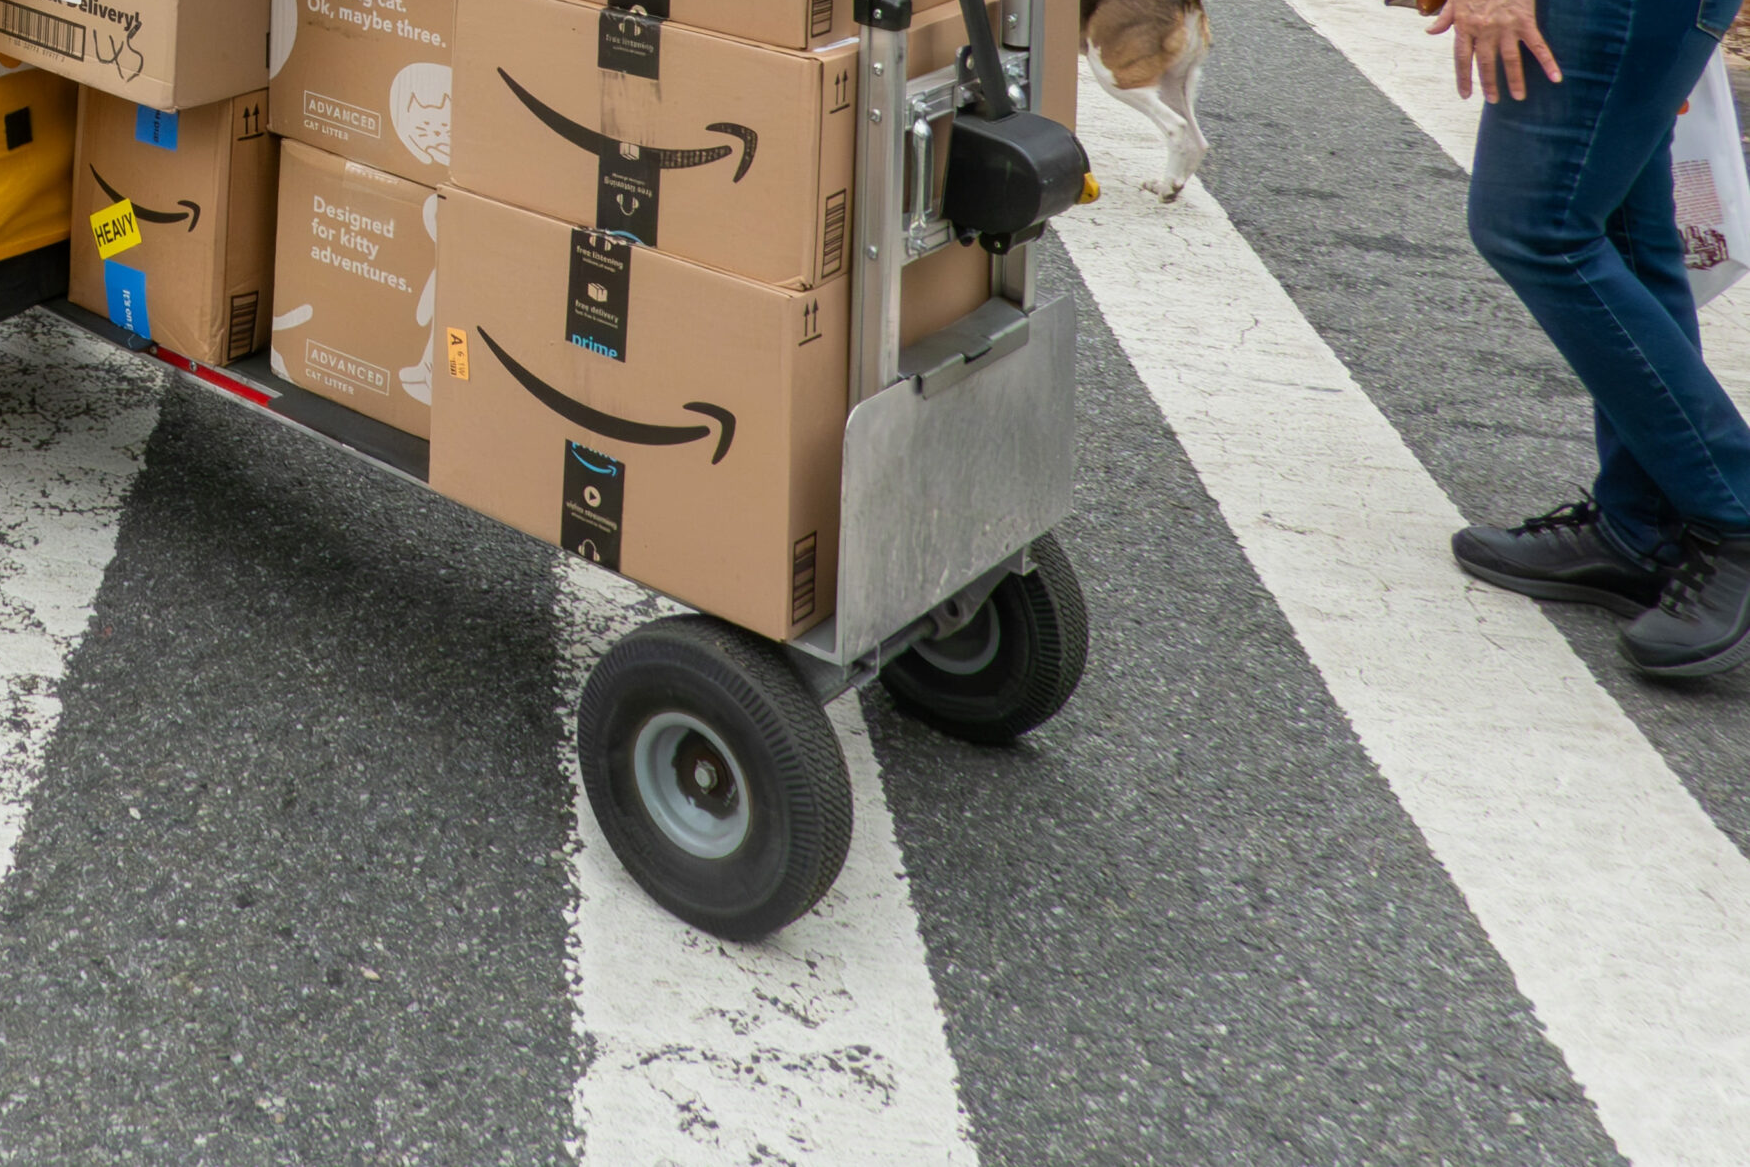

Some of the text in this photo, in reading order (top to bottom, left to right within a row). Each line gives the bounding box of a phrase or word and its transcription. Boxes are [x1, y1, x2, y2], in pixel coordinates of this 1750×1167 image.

[339, 6, 393, 32] maybe
[397, 19, 447, 48] three.
[606, 33, 654, 52] free listening
[308, 98, 376, 131] ADVANCED
[304, 119, 349, 141] CAT LITTER
[604, 176, 652, 198] free listening
[94, 211, 134, 248] HEAVY
[314, 195, 395, 238] Designed
[311, 217, 379, 260] for kitty
[310, 245, 413, 293] adventures.
[576, 245, 624, 270] free listening
[575, 299, 619, 324] free delivery
[450, 333, 463, 345] A
[571, 333, 618, 358] prime
[311, 348, 384, 387] ADVANCED
[306, 368, 354, 395] CAT LITTER
